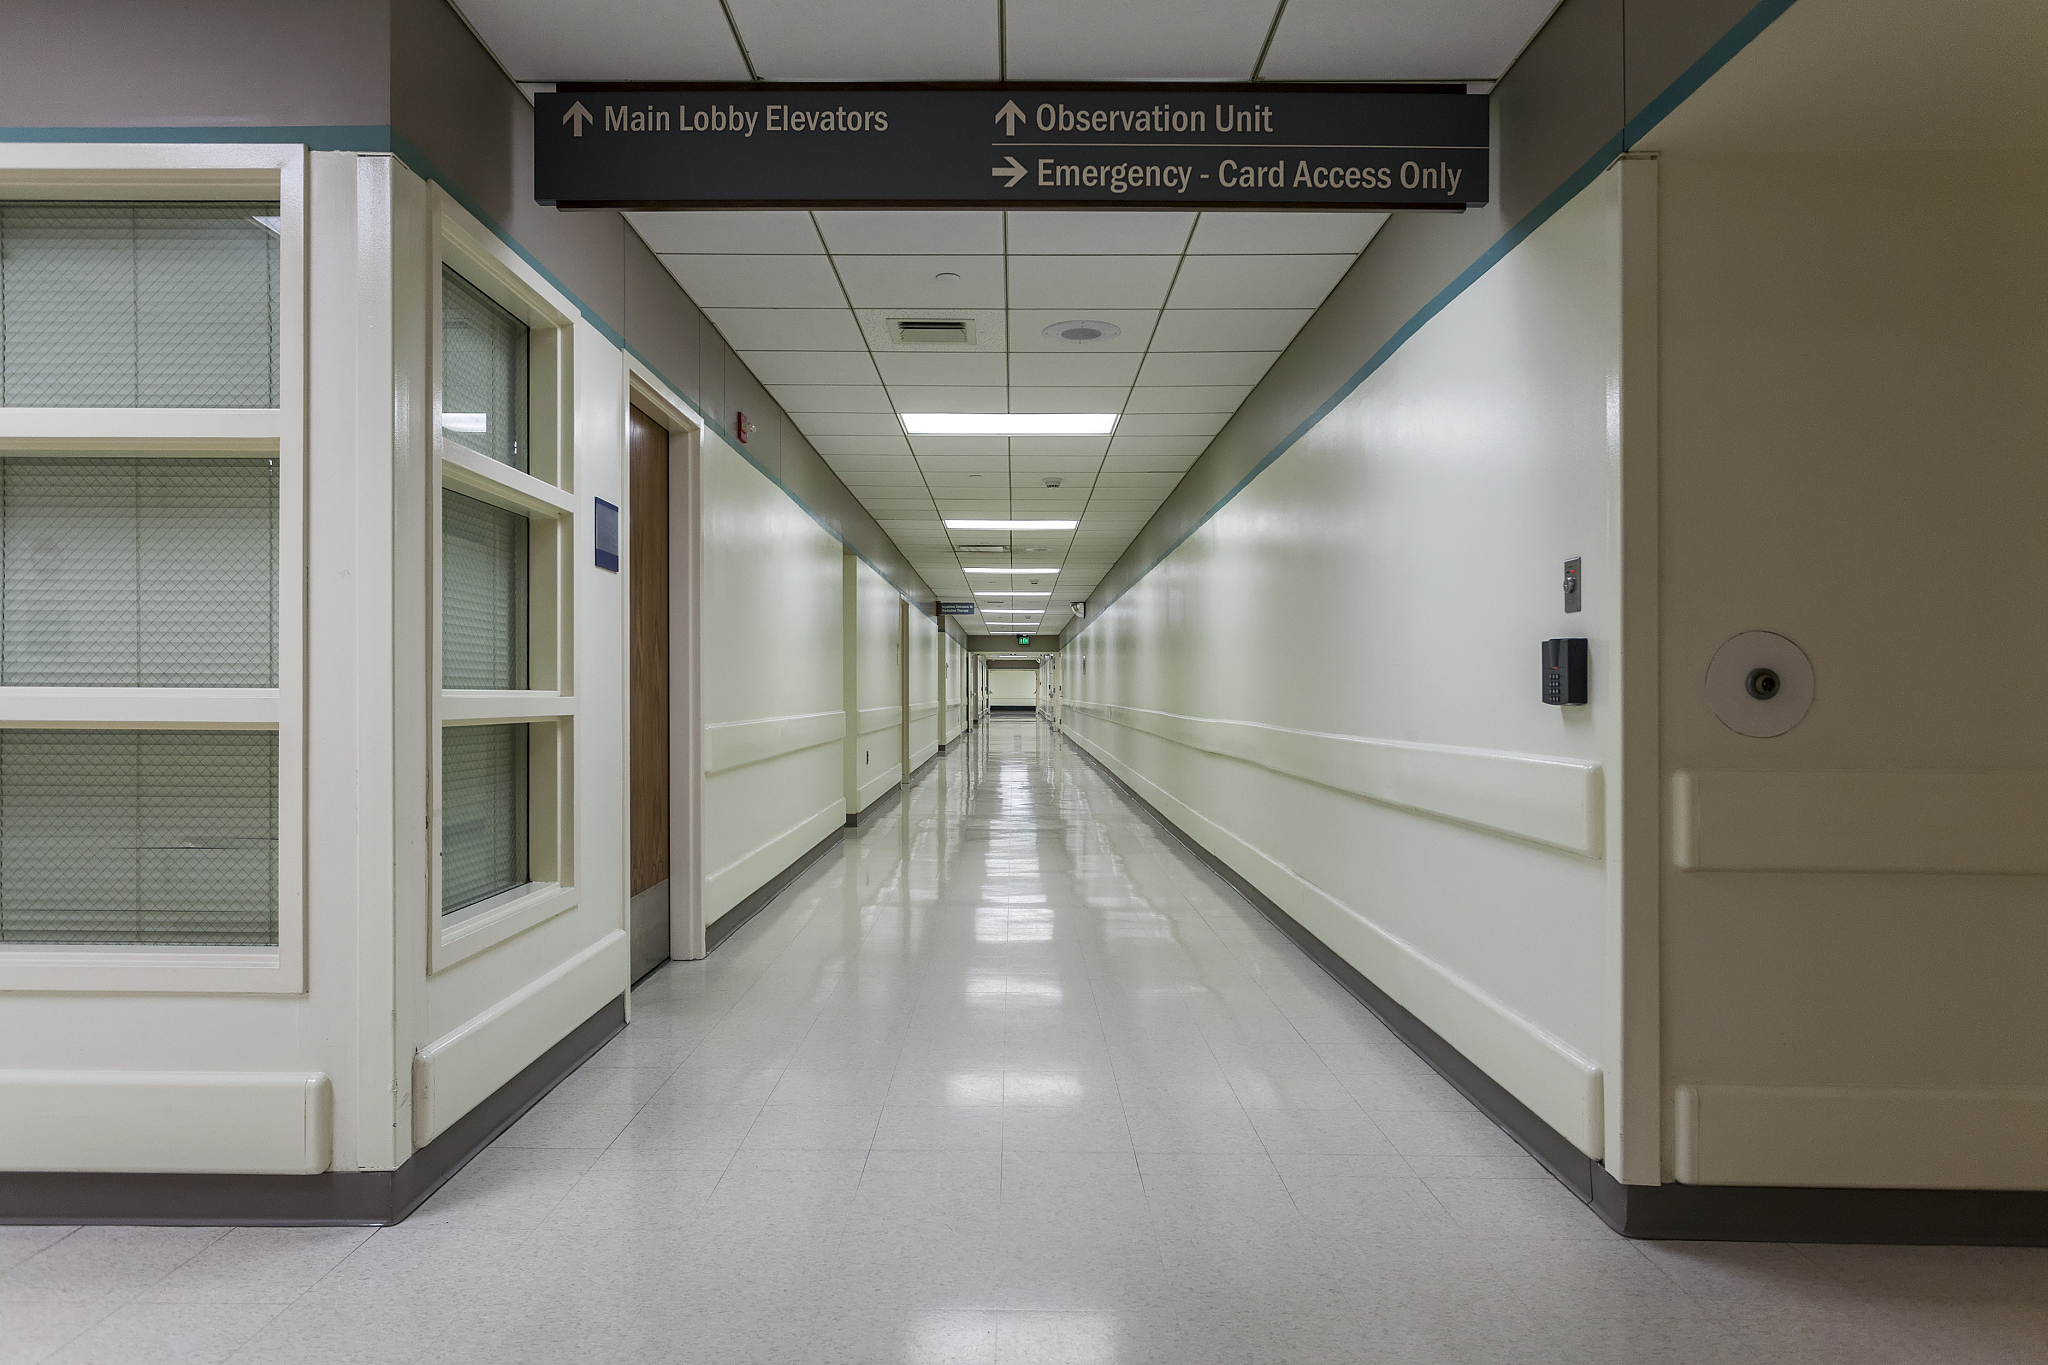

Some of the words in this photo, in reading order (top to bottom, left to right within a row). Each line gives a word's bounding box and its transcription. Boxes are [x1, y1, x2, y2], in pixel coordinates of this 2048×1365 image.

[605, 105, 670, 132] Main
[679, 105, 759, 138] Lobby
[766, 104, 889, 132] Elevators
[1036, 103, 1206, 132] Observation
[1215, 104, 1274, 133] Unit
[1038, 158, 1193, 194] Emergency
[1218, 159, 1285, 188] Card
[1292, 160, 1392, 189] Access
[1400, 161, 1462, 196] Only
